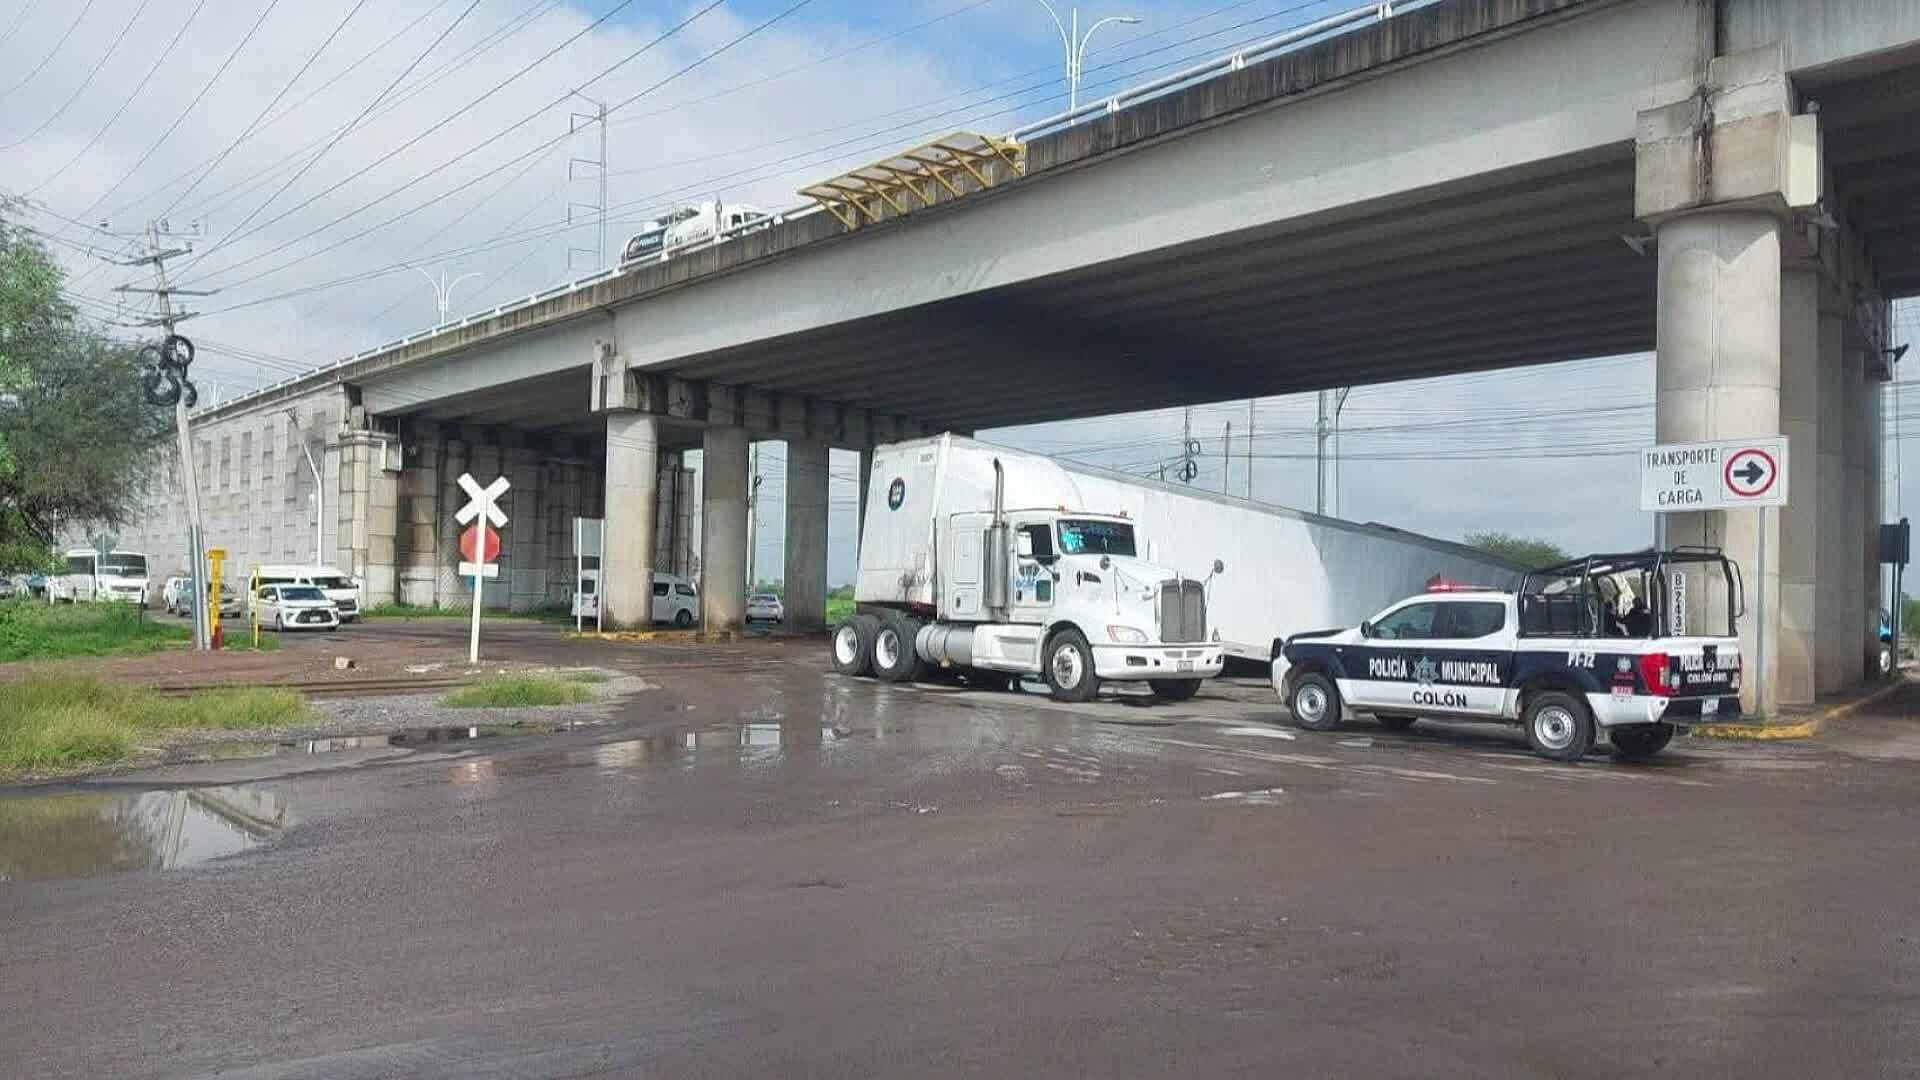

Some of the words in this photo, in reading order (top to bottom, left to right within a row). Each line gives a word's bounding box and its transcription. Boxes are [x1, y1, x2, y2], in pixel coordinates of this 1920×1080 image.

[1645, 447, 1717, 469] TRANSPORTE
[1673, 470, 1688, 486] DE
[1658, 488, 1703, 506] CARGA
[1369, 655, 1408, 678] POLICÍA
[1441, 660, 1500, 684] MUNICIPAL
[1412, 688, 1468, 707] COLÓN
